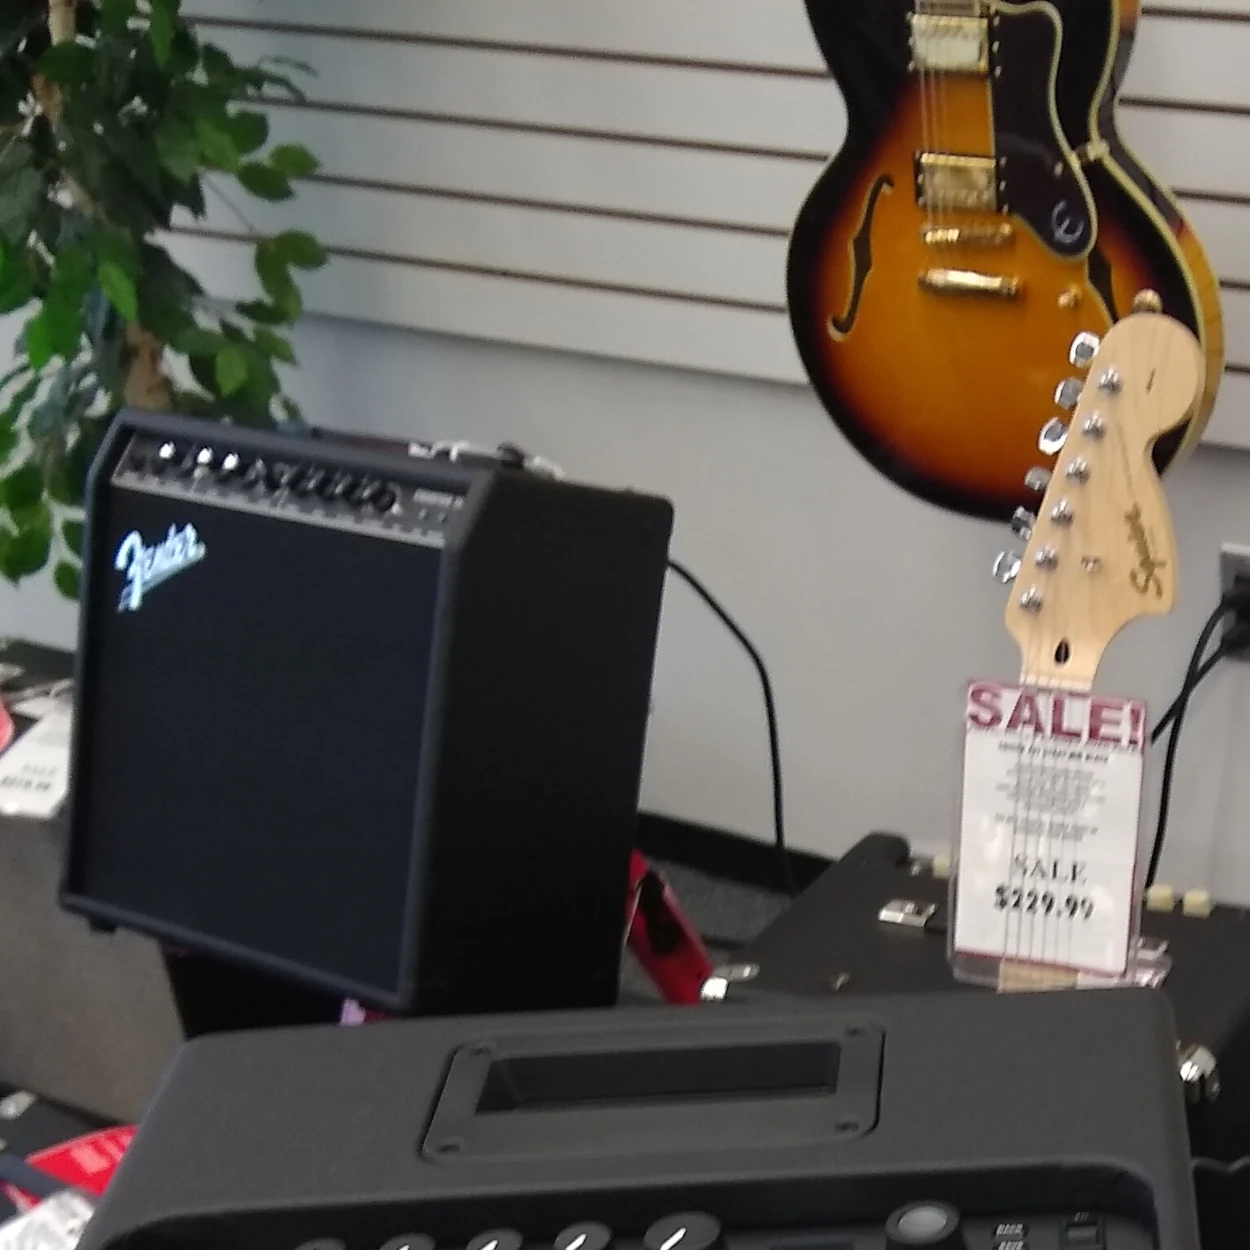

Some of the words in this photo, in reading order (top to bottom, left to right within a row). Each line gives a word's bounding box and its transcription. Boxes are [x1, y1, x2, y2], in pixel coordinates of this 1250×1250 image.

[114, 521, 207, 613] Fender
[968, 681, 1146, 747] SALE!
[1013, 853, 1088, 884] SALE
[994, 884, 1096, 921] $229.99
